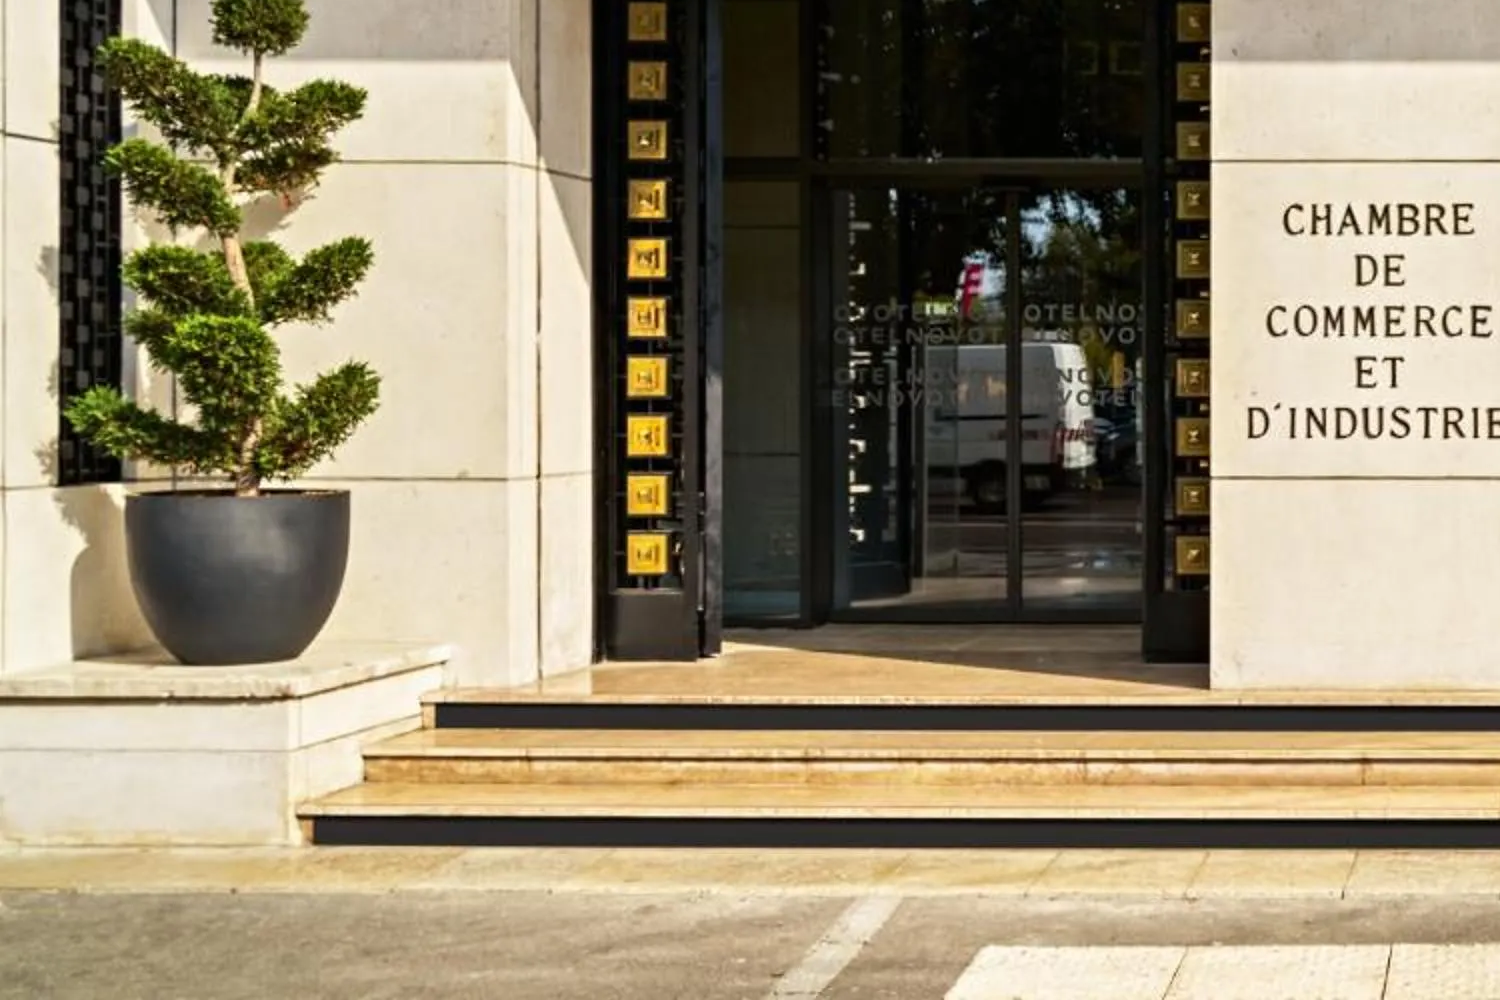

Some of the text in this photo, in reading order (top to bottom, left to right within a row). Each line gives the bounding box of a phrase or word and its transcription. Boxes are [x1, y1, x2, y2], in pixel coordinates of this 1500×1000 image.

[1282, 203, 1475, 237] CHAMBRE
[1354, 254, 1405, 287] DE
[1266, 304, 1493, 338] COMMERCE
[1355, 355, 1405, 389] ET
